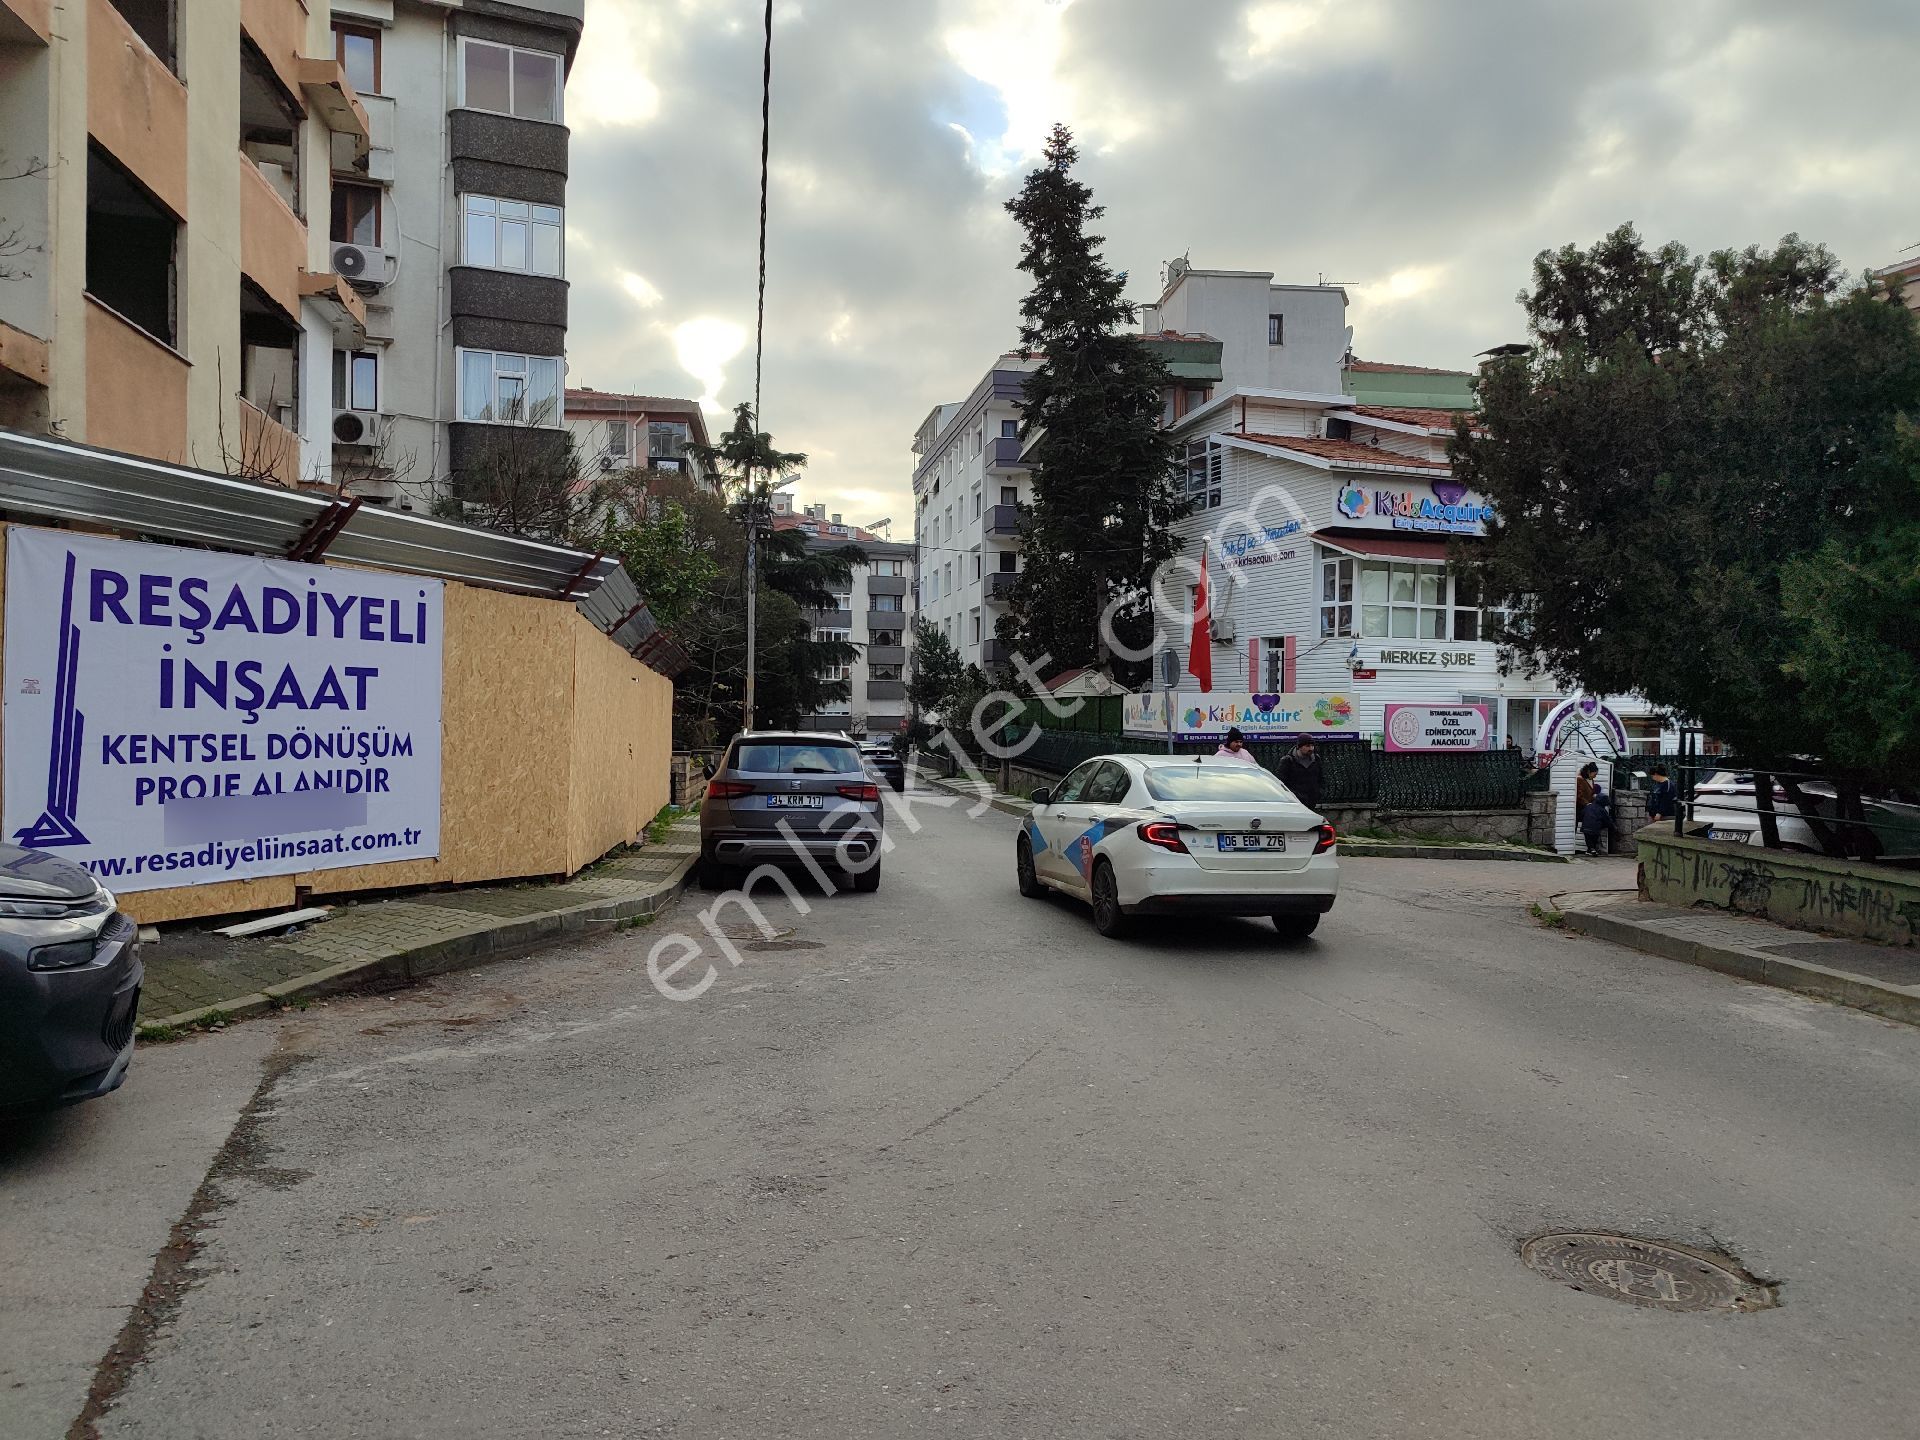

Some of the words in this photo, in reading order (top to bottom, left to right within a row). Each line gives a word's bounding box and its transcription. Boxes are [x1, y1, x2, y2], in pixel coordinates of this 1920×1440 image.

[1376, 491, 1495, 523] KidsAcquire
[1394, 518, 1413, 529] Early
[1413, 520, 1440, 531] English
[90, 568, 426, 645] REŞADİYELİ
[1380, 650, 1437, 665] MERKEZ
[1441, 651, 1476, 668] ŞUBE
[160, 643, 379, 725] İNŞAAT
[1208, 704, 1301, 725] KidsAcquire
[1442, 717, 1460, 726] ÖZEL
[1425, 727, 1452, 736] EDİNEN
[1452, 728, 1477, 739] ÇOCUK
[1431, 738, 1470, 746] ANAOKULU
[102, 733, 256, 765] KENTSEL
[267, 726, 413, 765] DÖNÜŞÜM
[135, 773, 241, 806] PROJE
[252, 767, 391, 797] ALANIDIR
[772, 795, 783, 805] 34
[806, 795, 821, 805] 717
[1225, 835, 1237, 847] 06
[1266, 835, 1284, 847] 276
